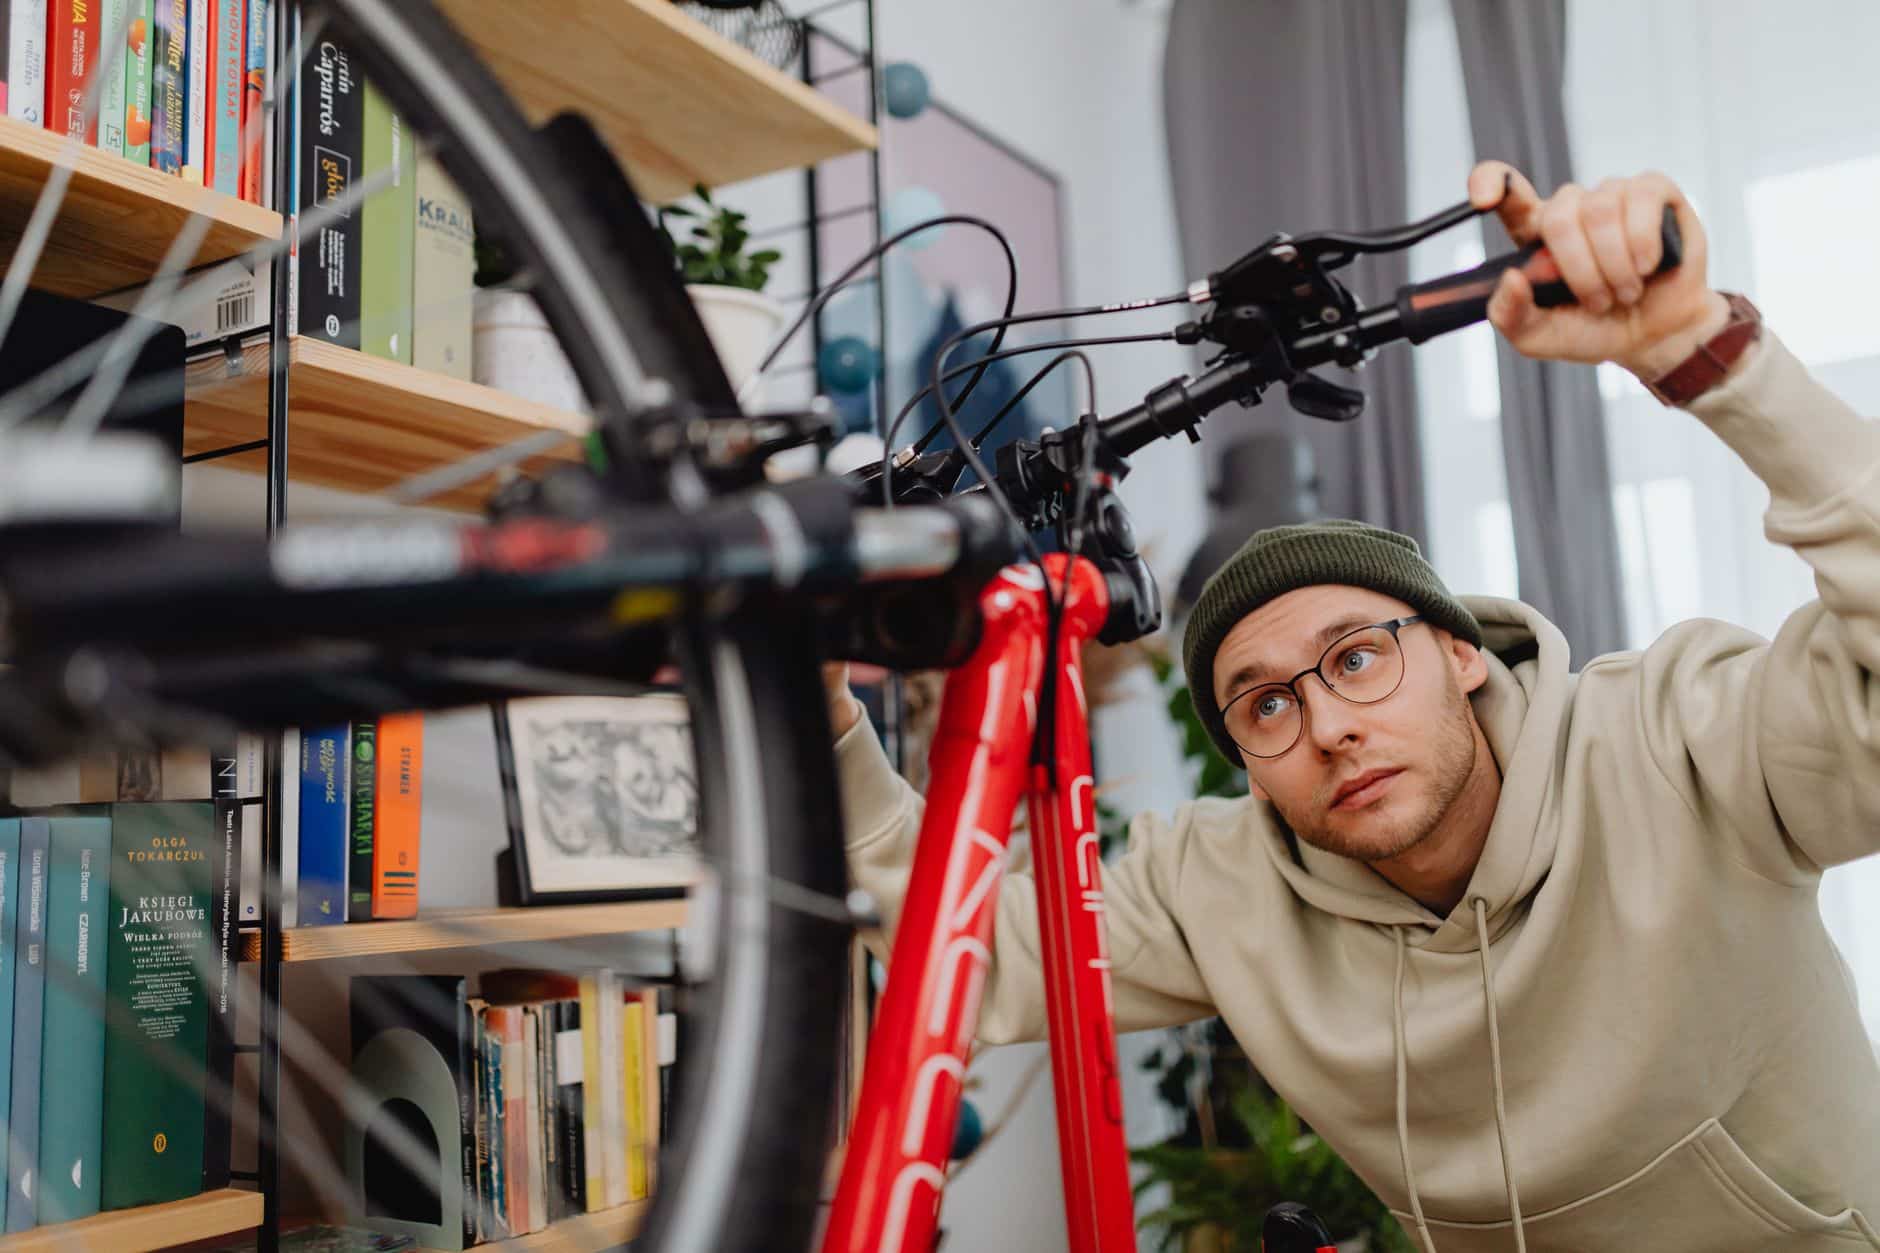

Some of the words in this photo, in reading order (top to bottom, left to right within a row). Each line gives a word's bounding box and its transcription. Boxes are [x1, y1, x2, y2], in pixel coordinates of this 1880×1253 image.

[167, 20, 186, 72] Potter
[226, 57, 238, 119] KOSSAK
[314, 41, 340, 136] Caparrós
[338, 51, 356, 95] artín
[353, 763, 374, 855] SUCHARKI
[127, 849, 206, 863] TOKARCZUK
[151, 836, 188, 849] OLGA
[80, 871, 91, 902] Brown
[119, 907, 206, 928] JAKUBOWE
[139, 895, 193, 910] KSIĘGI
[222, 889, 231, 921] Henryka
[77, 912, 89, 976] CZARNOBYL
[123, 932, 164, 943] WIELKA
[222, 922, 230, 938] Ryla
